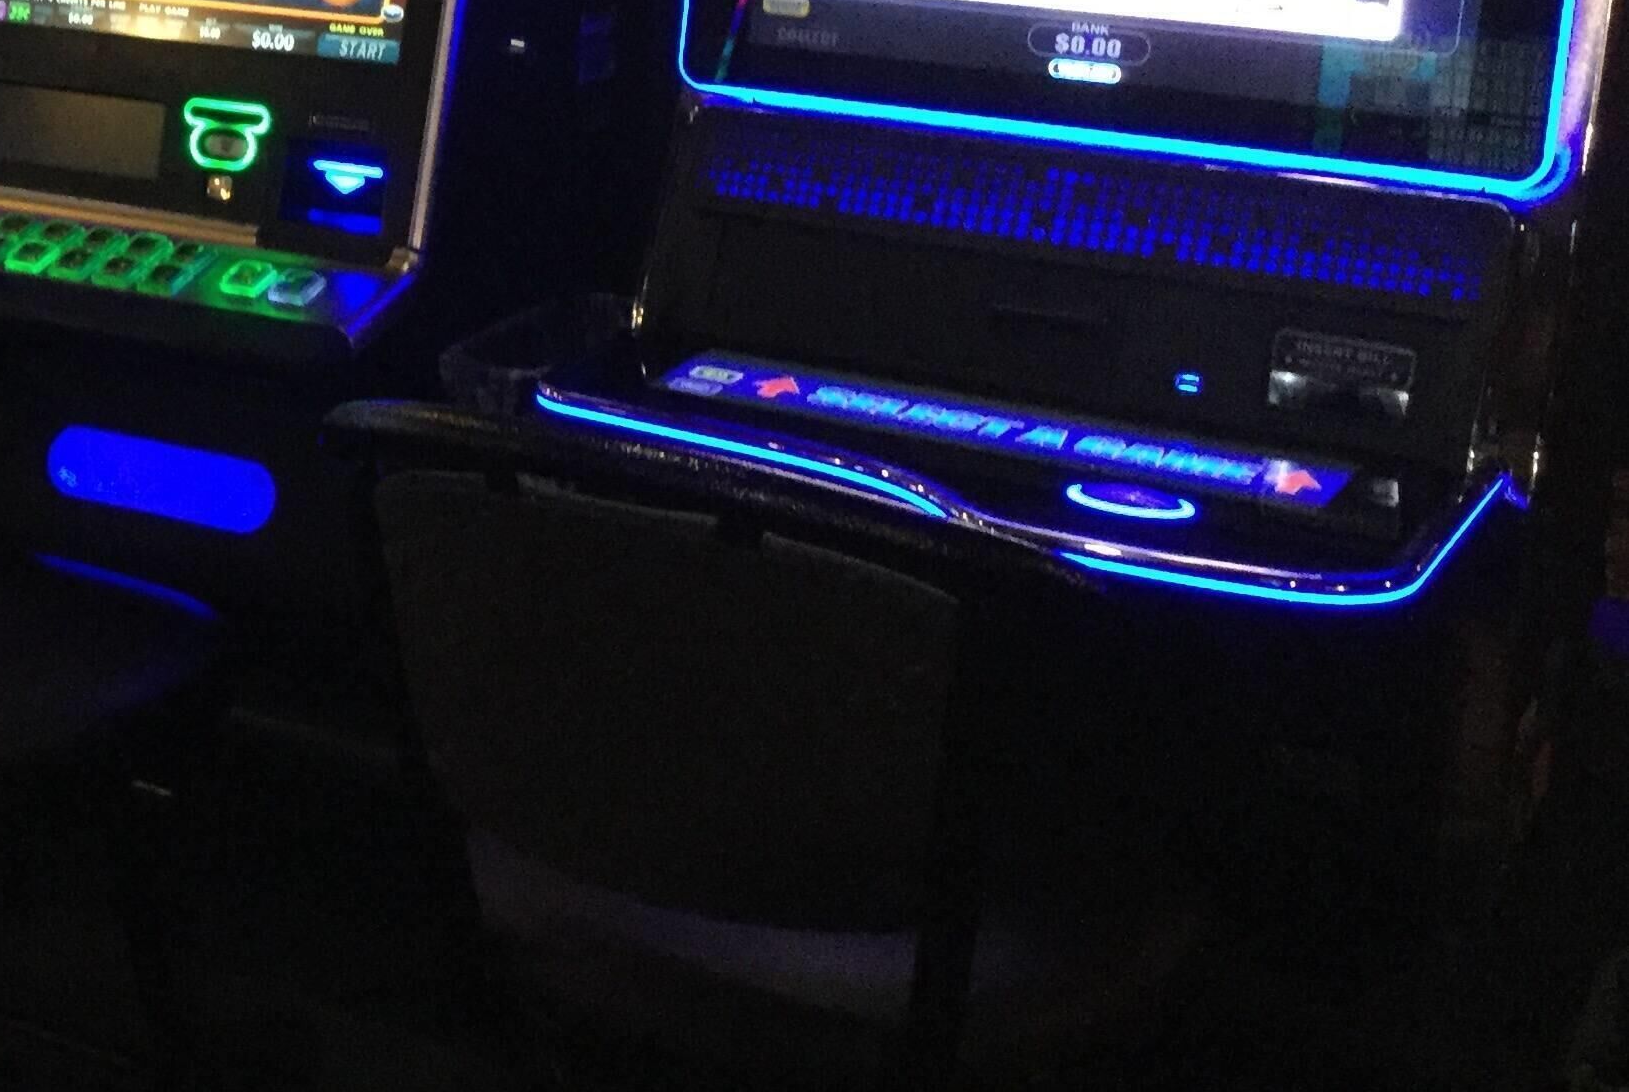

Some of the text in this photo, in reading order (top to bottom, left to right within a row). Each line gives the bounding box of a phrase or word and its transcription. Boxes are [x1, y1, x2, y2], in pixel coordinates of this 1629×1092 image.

[1072, 21, 1109, 36] BANK
[252, 30, 295, 52] $0.00
[339, 40, 387, 60] START
[1055, 33, 1122, 58] $0.00
